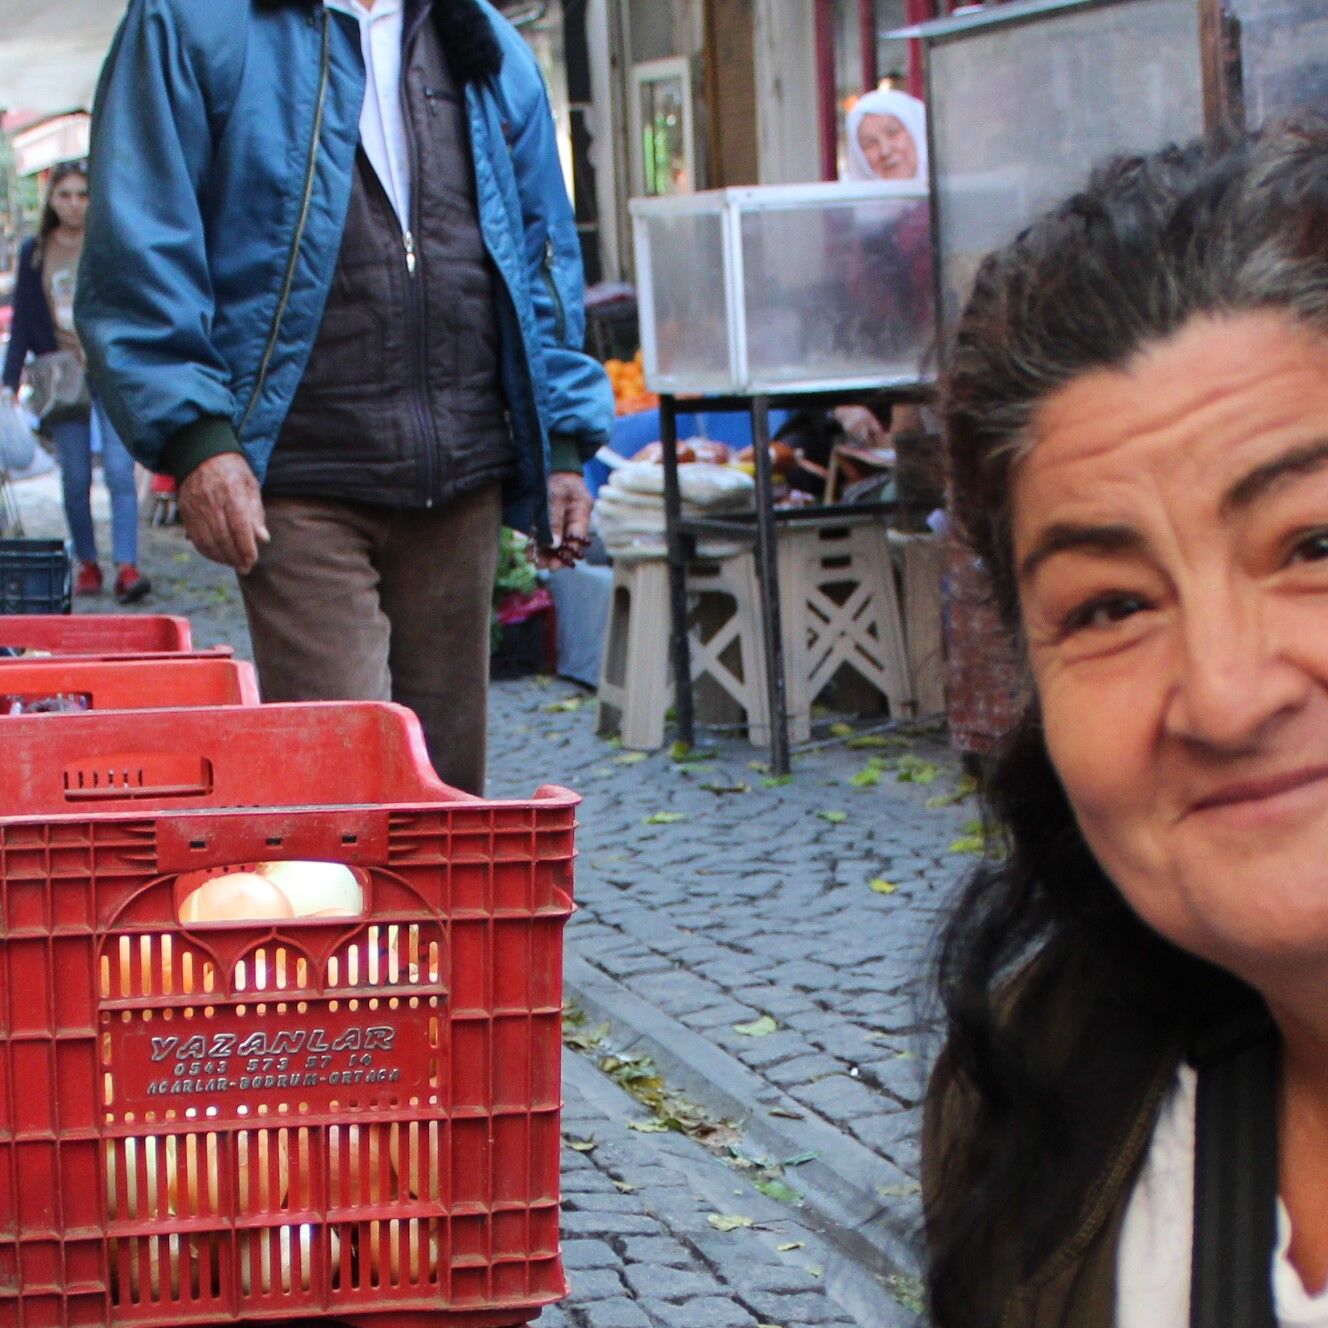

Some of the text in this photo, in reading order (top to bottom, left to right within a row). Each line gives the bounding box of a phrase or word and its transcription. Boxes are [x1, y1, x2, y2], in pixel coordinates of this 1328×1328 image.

[151, 1026, 396, 1061] YAZANLAR
[174, 1061, 228, 1076] 0543
[247, 1058, 290, 1072] 573
[304, 1055, 332, 1069] 57
